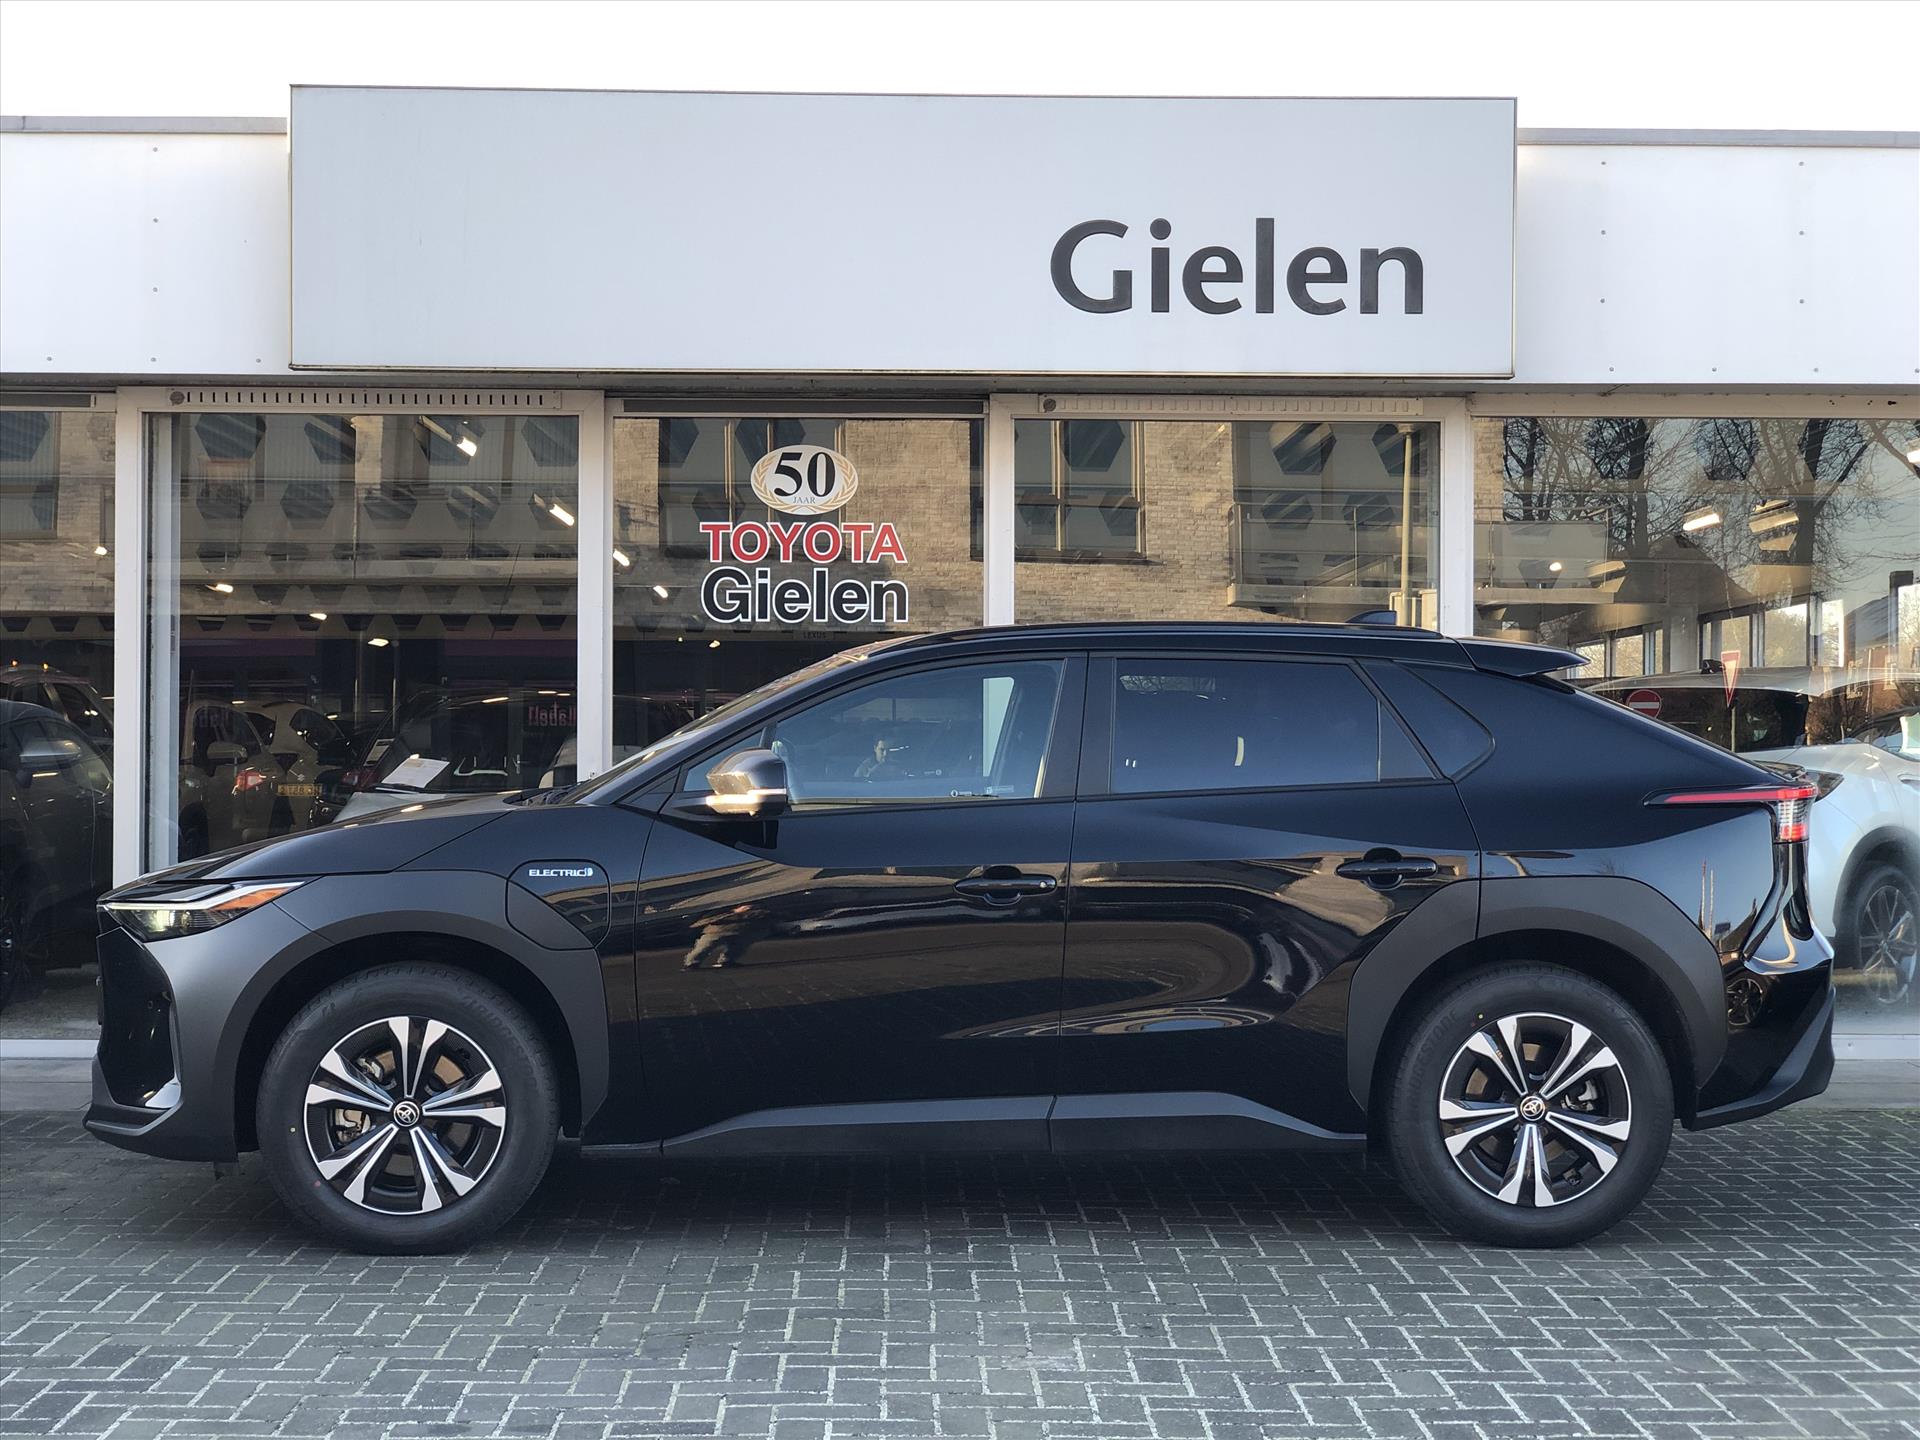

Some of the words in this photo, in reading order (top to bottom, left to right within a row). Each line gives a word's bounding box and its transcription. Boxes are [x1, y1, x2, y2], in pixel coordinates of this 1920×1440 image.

[1050, 217, 1424, 316] Gielen
[774, 452, 836, 497] 50
[792, 496, 816, 505] JAAR
[700, 522, 908, 564] TOYOTA
[701, 566, 908, 624] Gielen
[529, 868, 587, 877] ELECTRIC
